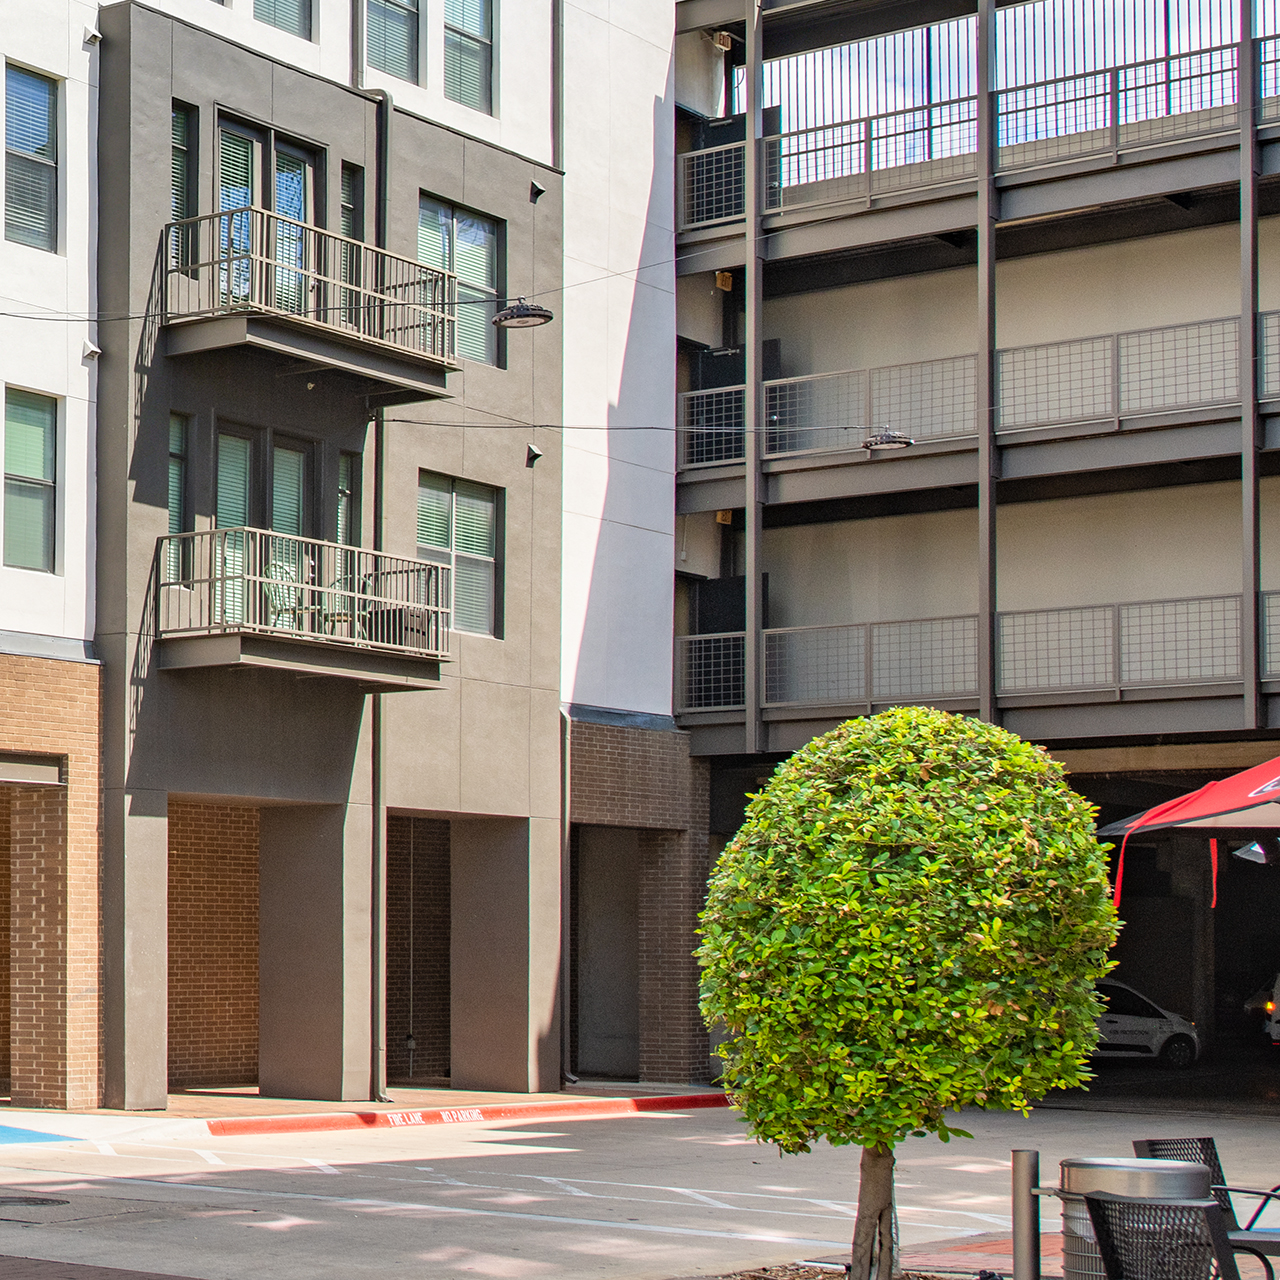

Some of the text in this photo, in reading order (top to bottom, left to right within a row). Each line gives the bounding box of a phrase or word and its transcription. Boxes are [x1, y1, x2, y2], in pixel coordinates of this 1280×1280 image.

[387, 1109, 484, 1126] FIRE LANE NO PARKING
